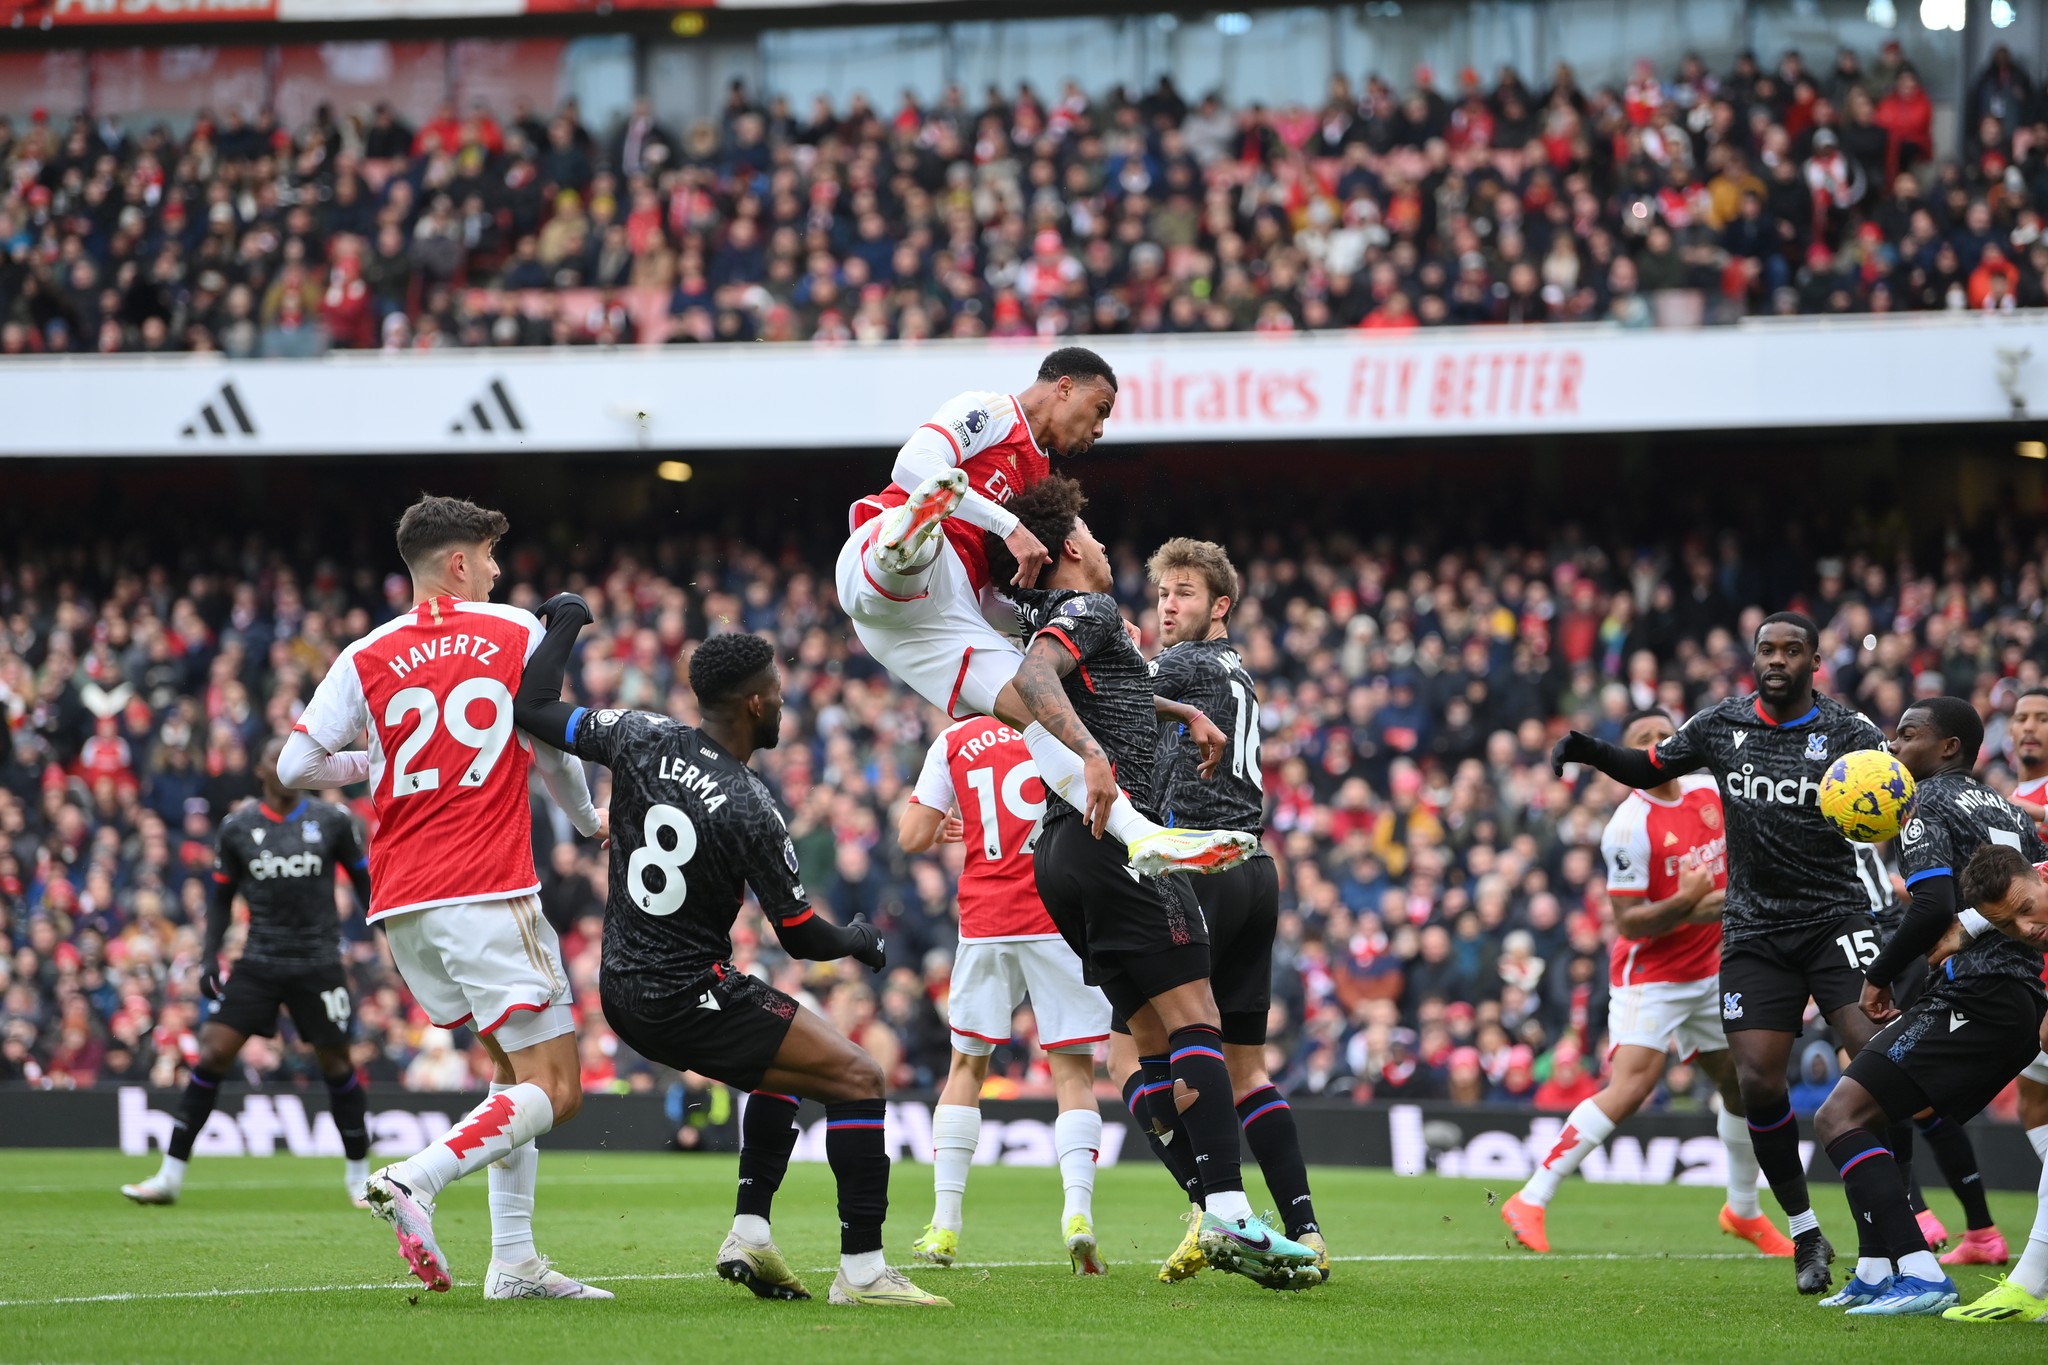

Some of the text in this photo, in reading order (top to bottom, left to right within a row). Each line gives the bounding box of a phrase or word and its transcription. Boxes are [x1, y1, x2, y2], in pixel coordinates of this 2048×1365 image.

[1346, 355, 1418, 419] FLY
[1428, 348, 1586, 418] BETTER
[388, 634, 500, 679] HAVERTZ
[385, 677, 514, 798] 29
[658, 756, 727, 814] LERMA
[1726, 763, 1820, 806] cinch
[967, 760, 1048, 861] 19
[1955, 789, 2024, 831] MITCHELL
[249, 850, 323, 880] cinch
[627, 804, 697, 916] 8
[1836, 930, 1880, 969] 15
[320, 986, 351, 1022] 10
